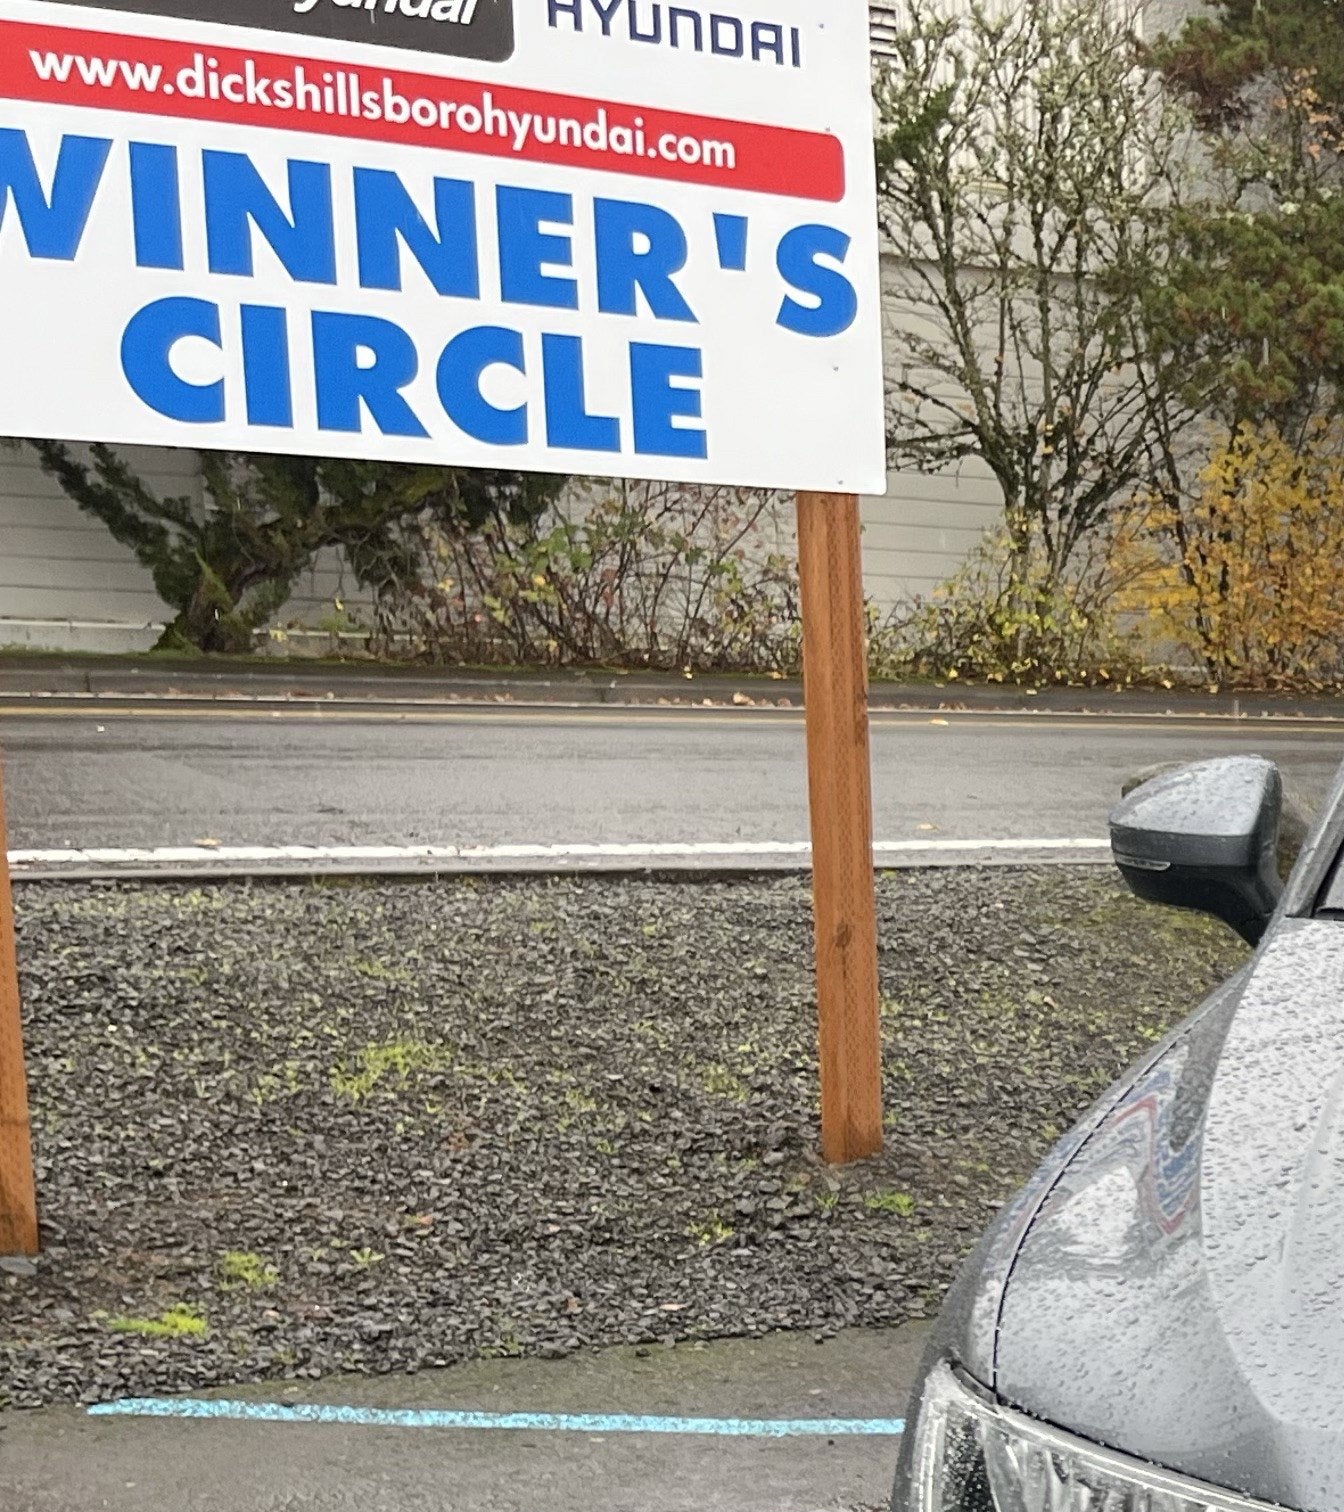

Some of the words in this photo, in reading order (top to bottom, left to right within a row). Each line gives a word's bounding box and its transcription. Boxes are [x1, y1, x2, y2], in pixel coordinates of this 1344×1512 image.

[547, 0, 801, 68] HYUNDAI
[29, 46, 736, 169] www.dickshillsborohyundai.com
[0, 127, 858, 337] WINNER'S
[120, 296, 708, 459] CIRCLE
